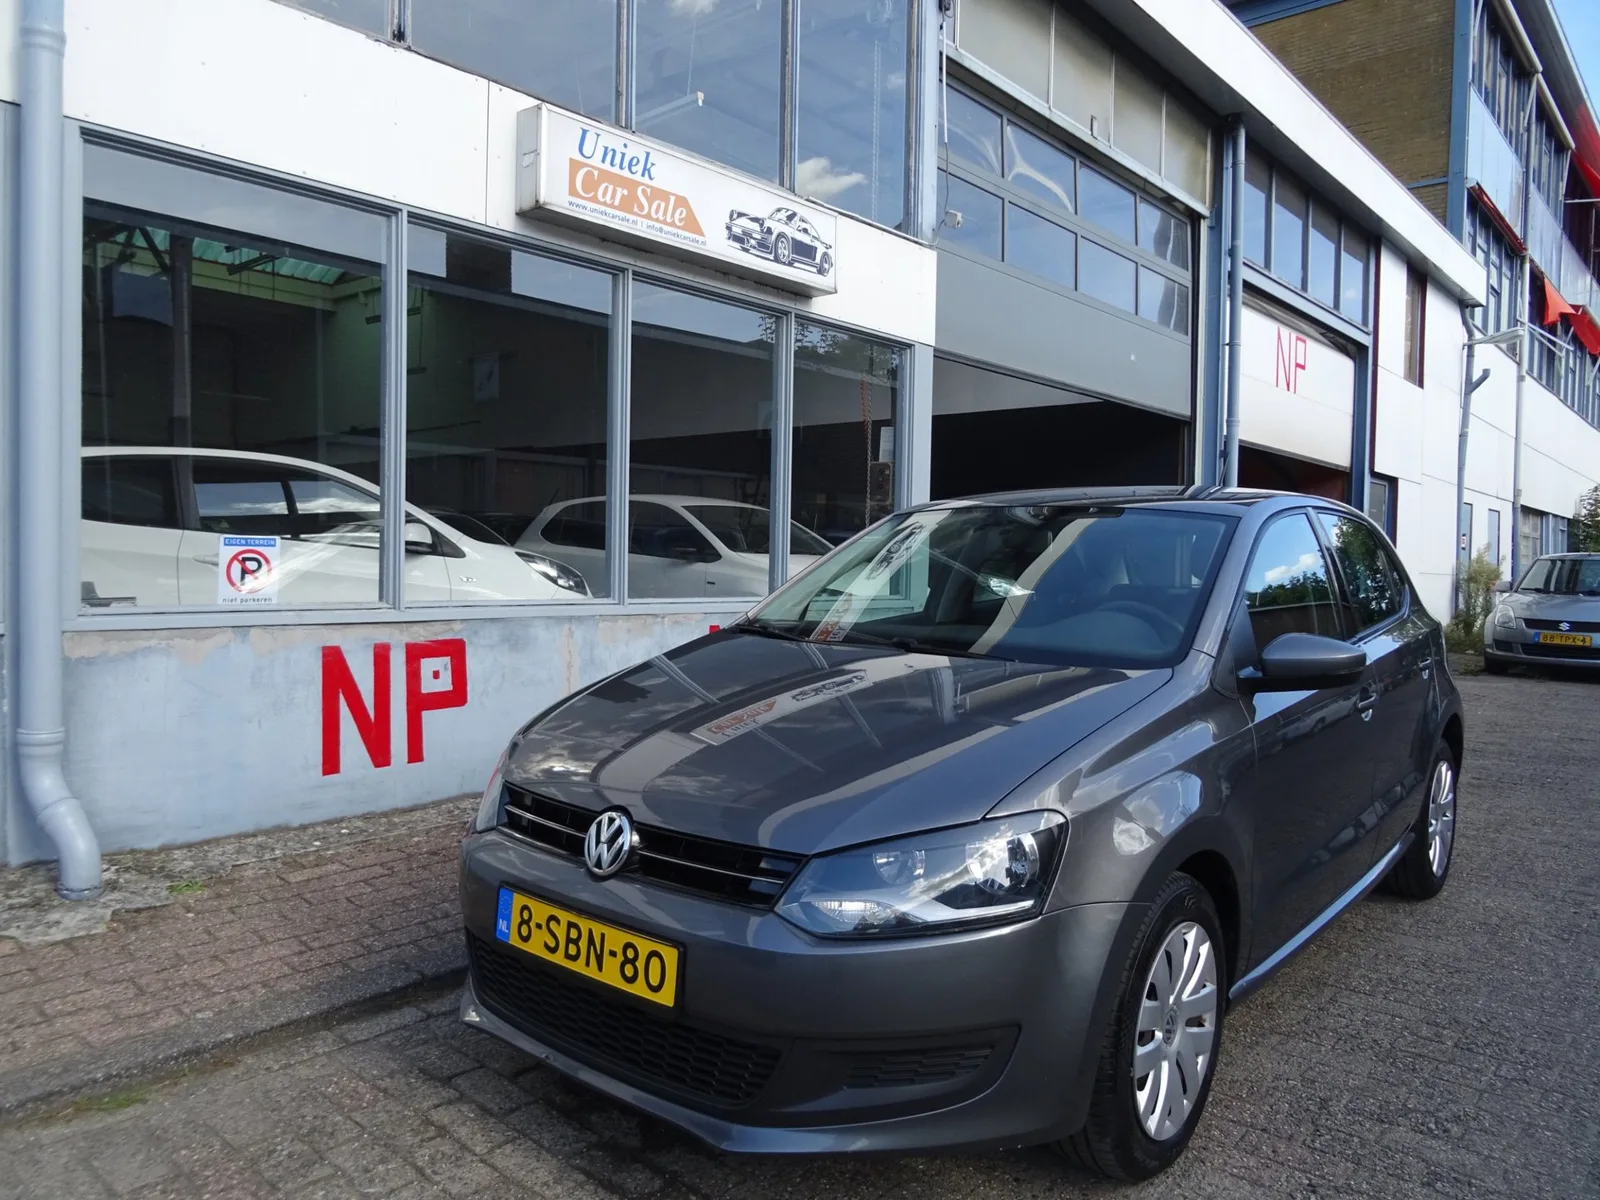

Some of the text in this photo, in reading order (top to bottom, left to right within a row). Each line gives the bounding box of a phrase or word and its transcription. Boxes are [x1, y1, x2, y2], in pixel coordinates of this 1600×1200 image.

[578, 127, 656, 181] Uniek
[567, 200, 707, 247] www.uniekcarsale.nl info@uniekcarsale.nl
[575, 167, 687, 227] Car Sale
[1275, 325, 1307, 395] NP
[225, 537, 275, 546] EIGEN TERREIN
[222, 596, 272, 605] niet parkeren
[322, 638, 468, 776] NP
[498, 918, 509, 933] NL
[517, 903, 667, 994] 8-SBN-80
